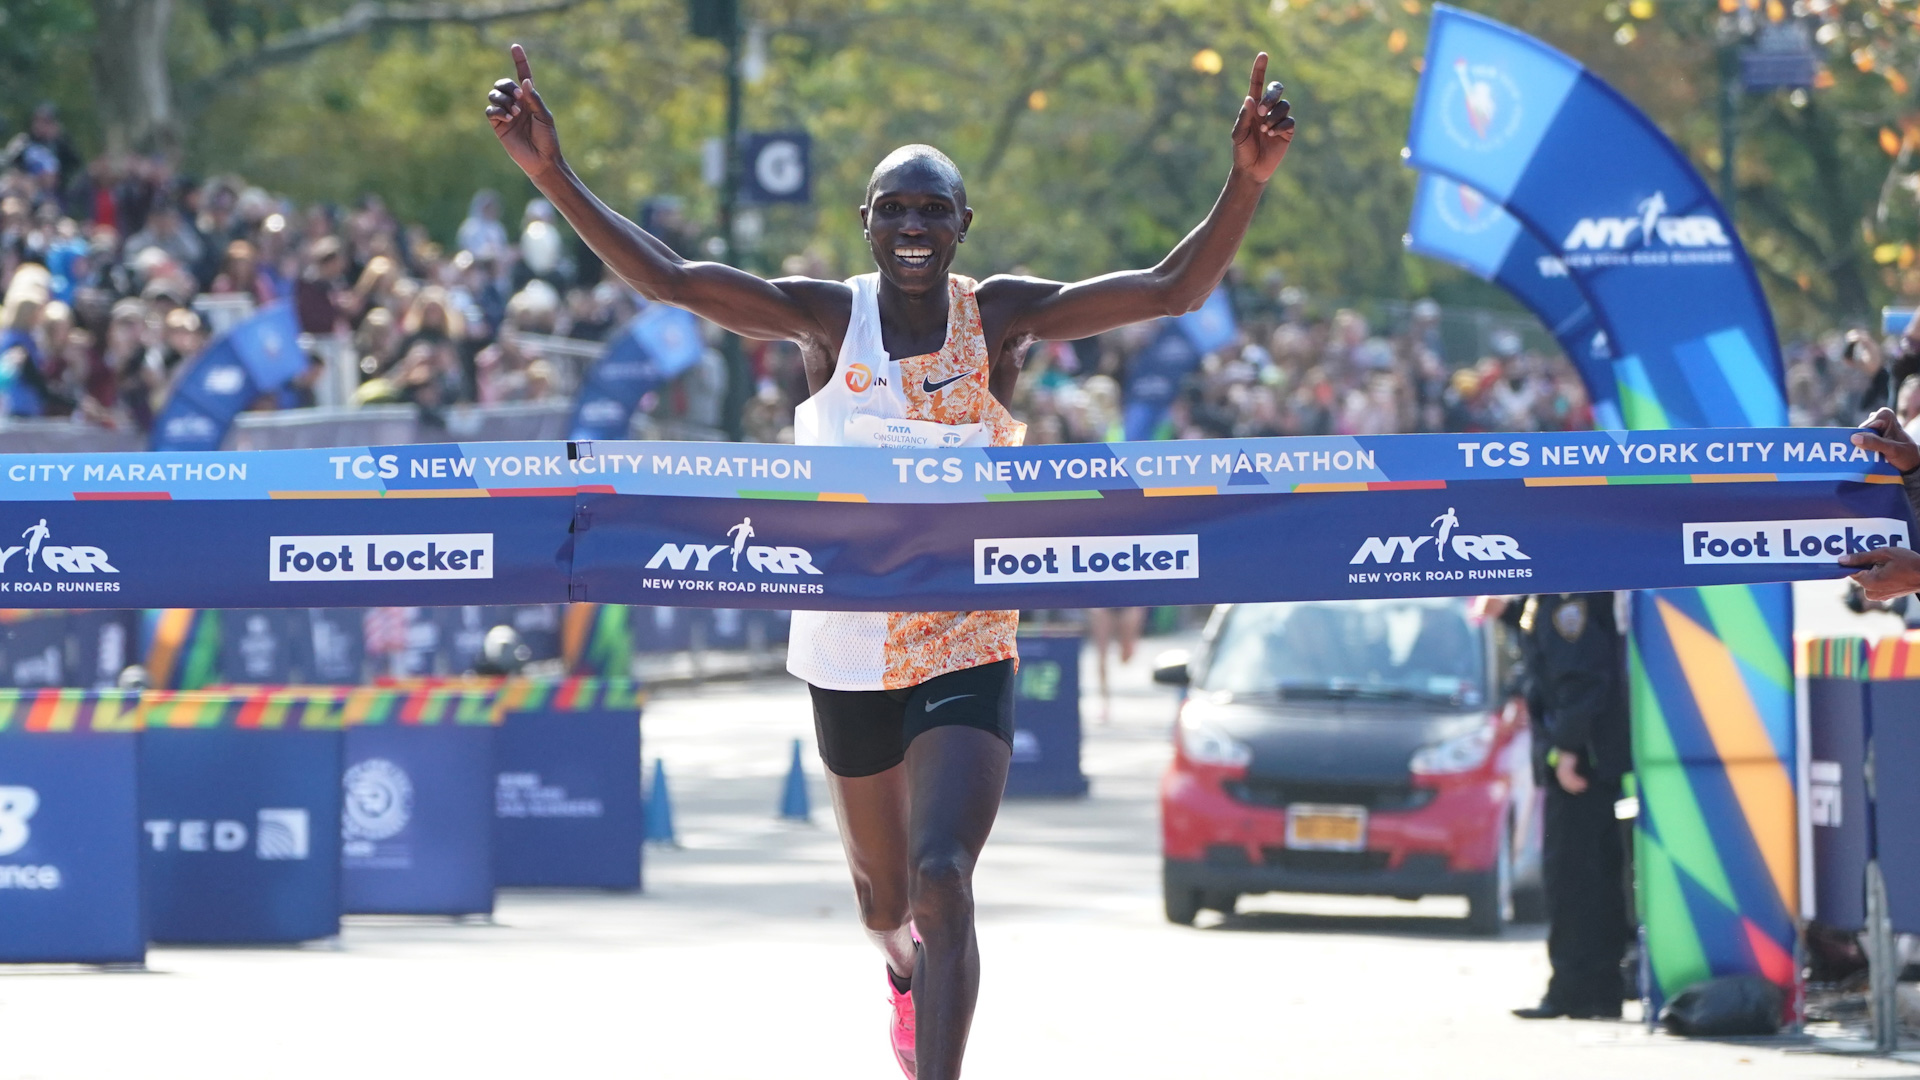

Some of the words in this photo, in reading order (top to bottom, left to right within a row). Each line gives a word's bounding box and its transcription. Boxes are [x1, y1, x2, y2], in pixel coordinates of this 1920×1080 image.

[756, 140, 803, 194] G
[887, 425, 911, 434] TATA
[329, 454, 399, 480] TCS
[410, 457, 476, 478] NEW
[484, 455, 562, 477] YORK
[577, 454, 643, 474] CITY
[652, 455, 812, 479] MARATHON
[892, 457, 963, 484] TCS
[974, 460, 1042, 482] NEW
[1049, 457, 1129, 479] YORK
[1135, 454, 1202, 476] CITY
[1211, 450, 1375, 474] MARATHON
[1458, 441, 1530, 467] TCS
[1542, 444, 1610, 466] NEW
[1618, 443, 1698, 464] YORK
[1706, 442, 1774, 462] CITY
[8, 464, 75, 482] CITY
[83, 463, 247, 481] MARATHON
[367, 542, 484, 572] Locker
[1349, 534, 1532, 564] NYRR
[1783, 527, 1902, 557] Locker
[644, 543, 824, 575] NYRR
[1072, 543, 1189, 573] Locker
[14, 582, 52, 592] ROAD
[56, 582, 120, 592] RUNNERS
[643, 579, 675, 591] NEW
[678, 579, 714, 592] YORK
[718, 581, 756, 592] ROAD
[760, 582, 824, 594] RUNNERS
[1348, 573, 1381, 583] NEW
[1384, 571, 1421, 583] YORK
[1425, 570, 1464, 581] ROAD
[1468, 568, 1533, 580] RUNNERS
[143, 820, 248, 851] TED
